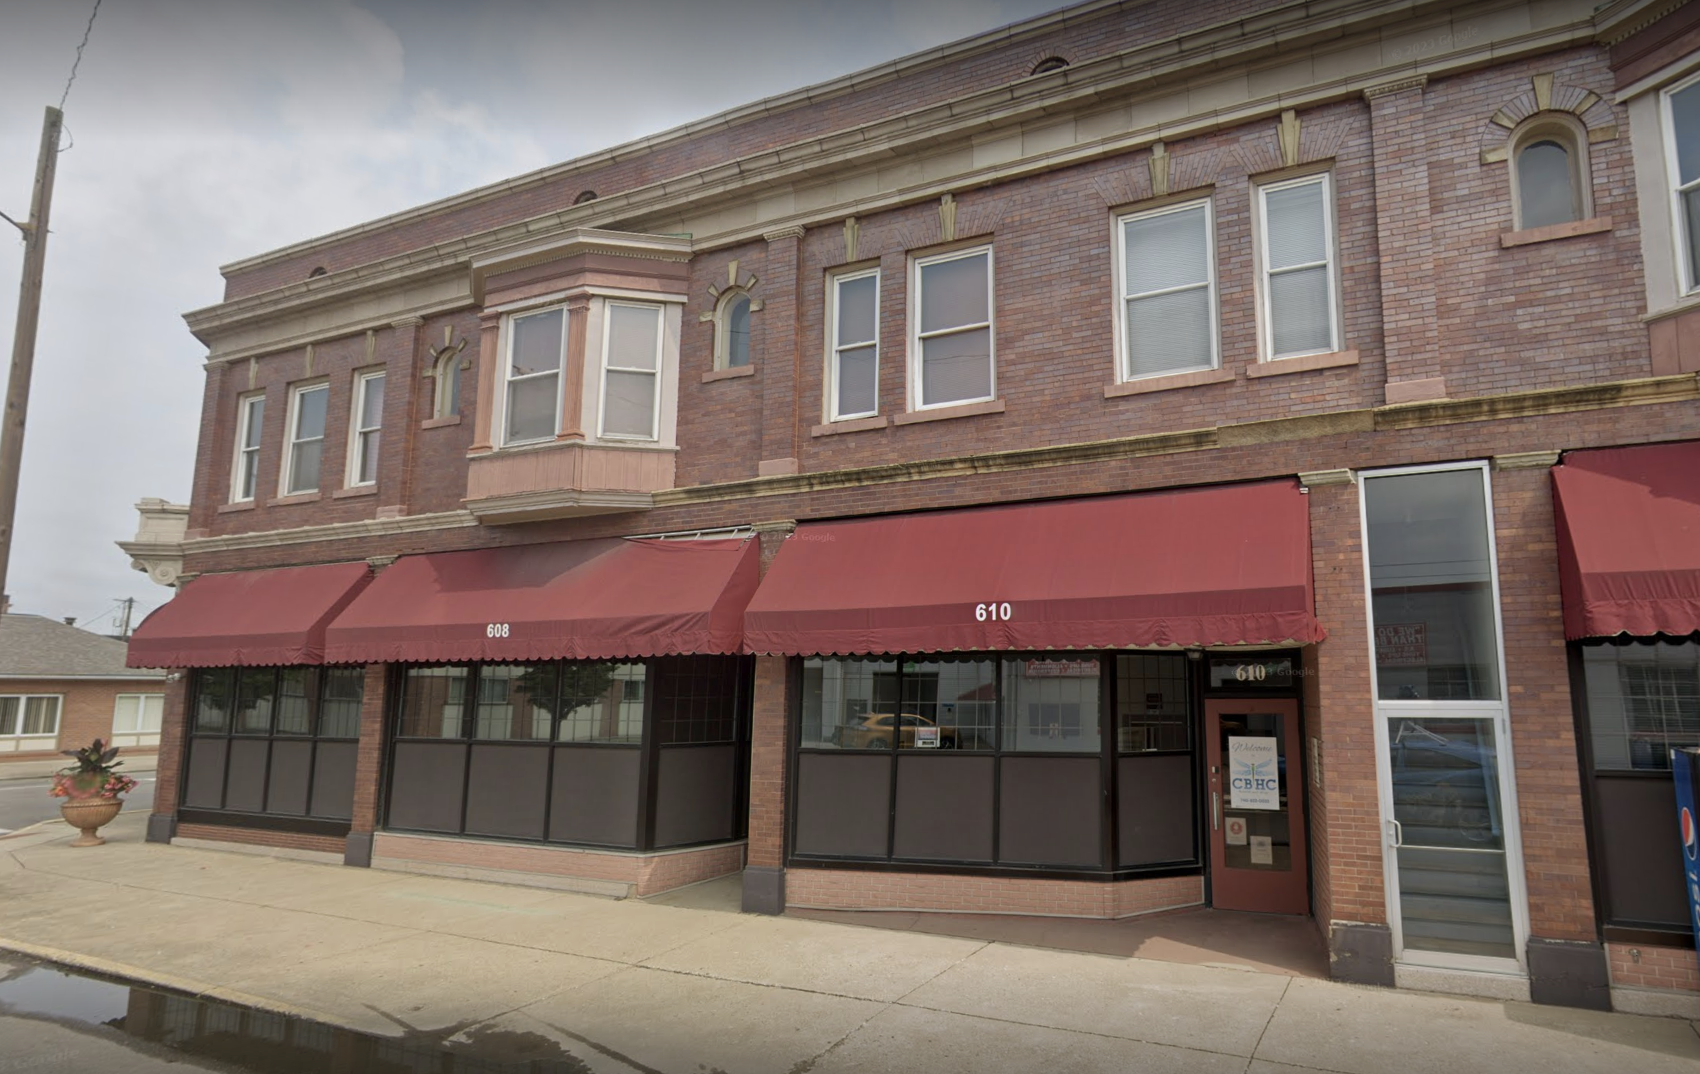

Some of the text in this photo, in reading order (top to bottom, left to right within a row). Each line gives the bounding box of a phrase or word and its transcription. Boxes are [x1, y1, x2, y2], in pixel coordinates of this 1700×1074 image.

[975, 602, 1012, 621] 610
[486, 623, 510, 638] 608
[1236, 664, 1266, 681] 610
[1231, 742, 1274, 753] Welcome
[1232, 778, 1277, 791] CBHC
